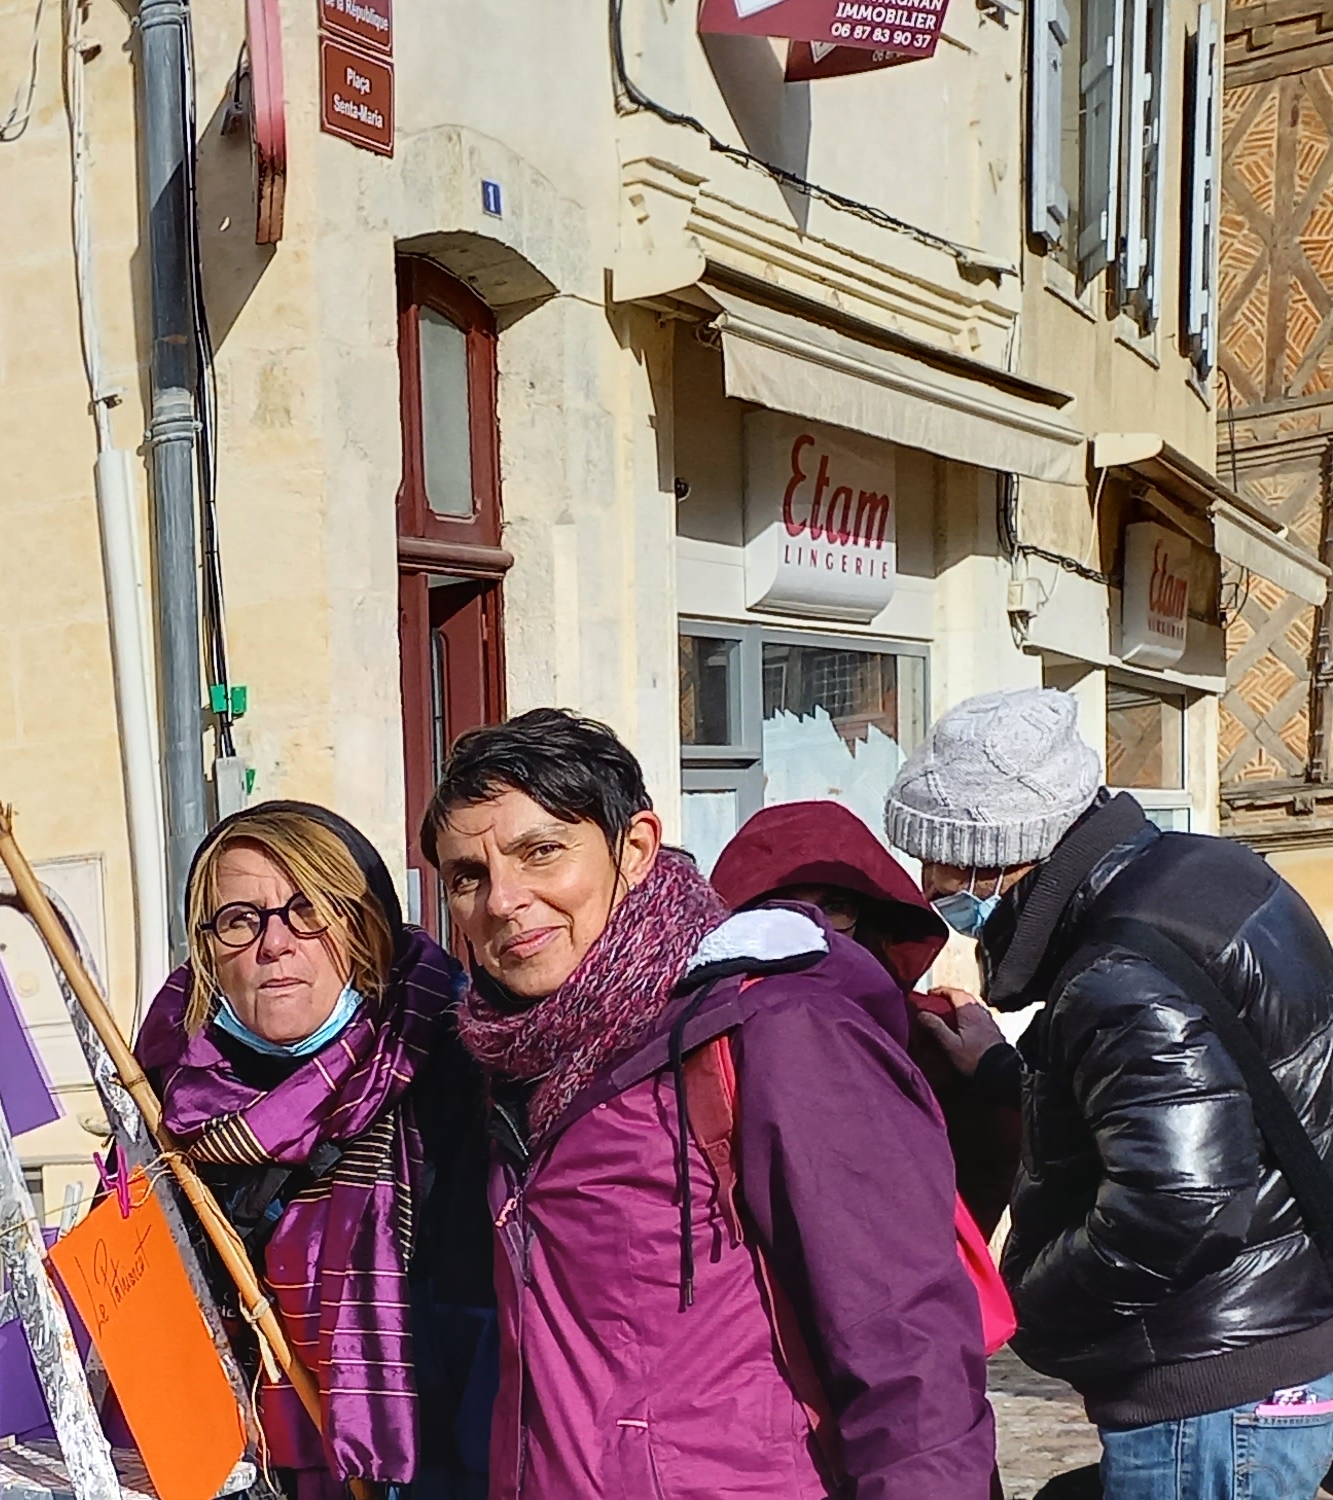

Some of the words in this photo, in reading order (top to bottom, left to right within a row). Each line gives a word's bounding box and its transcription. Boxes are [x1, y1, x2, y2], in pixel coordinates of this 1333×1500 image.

[835, 4, 937, 30] IMMOBILIER
[832, 22, 851, 37] 06
[853, 25, 870, 40] 87
[872, 28, 890, 43] 83
[893, 30, 911, 46] 90
[913, 33, 932, 49] 37
[346, 67, 371, 94] Plaça
[333, 93, 383, 128] Senta-Maria
[782, 433, 890, 550] Etam
[784, 544, 888, 580] LINGERIE
[1149, 538, 1189, 621] Etam
[74, 1255, 110, 1340] Le
